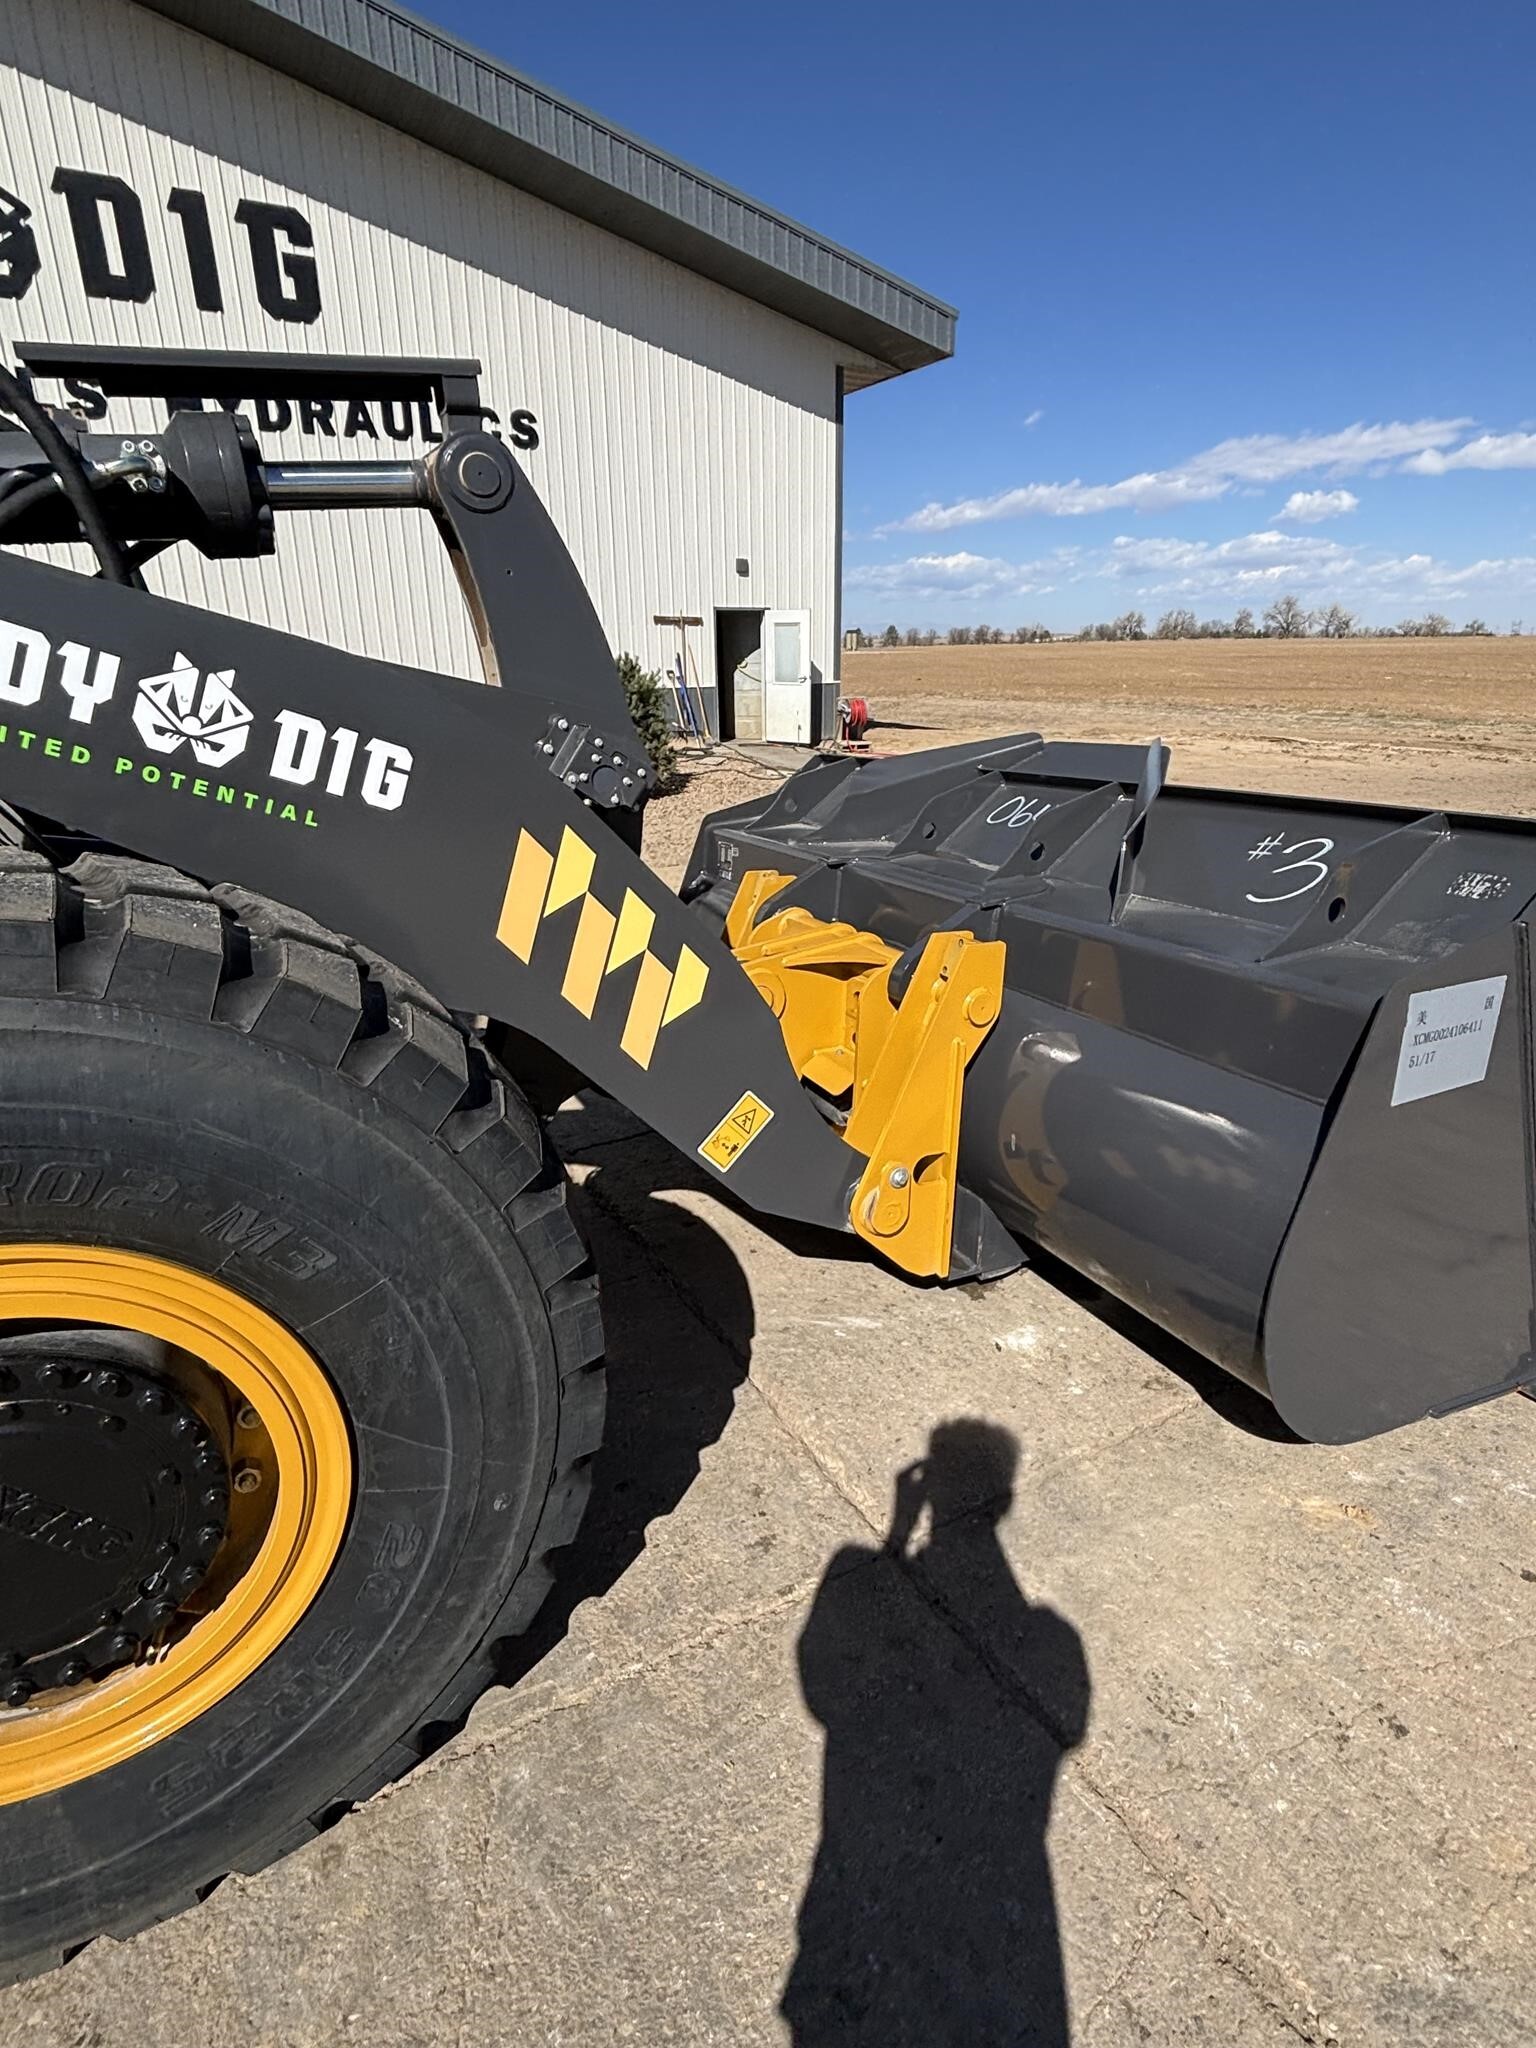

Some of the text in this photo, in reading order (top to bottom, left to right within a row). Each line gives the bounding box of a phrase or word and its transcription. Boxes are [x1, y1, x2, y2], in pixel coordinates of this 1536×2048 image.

[52, 166, 323, 324] DIG
[115, 757, 318, 828] POTENTIAL
[269, 708, 414, 811] DIG
[1246, 832, 1335, 903] #3
[1408, 1051, 1437, 1069] 51/17
